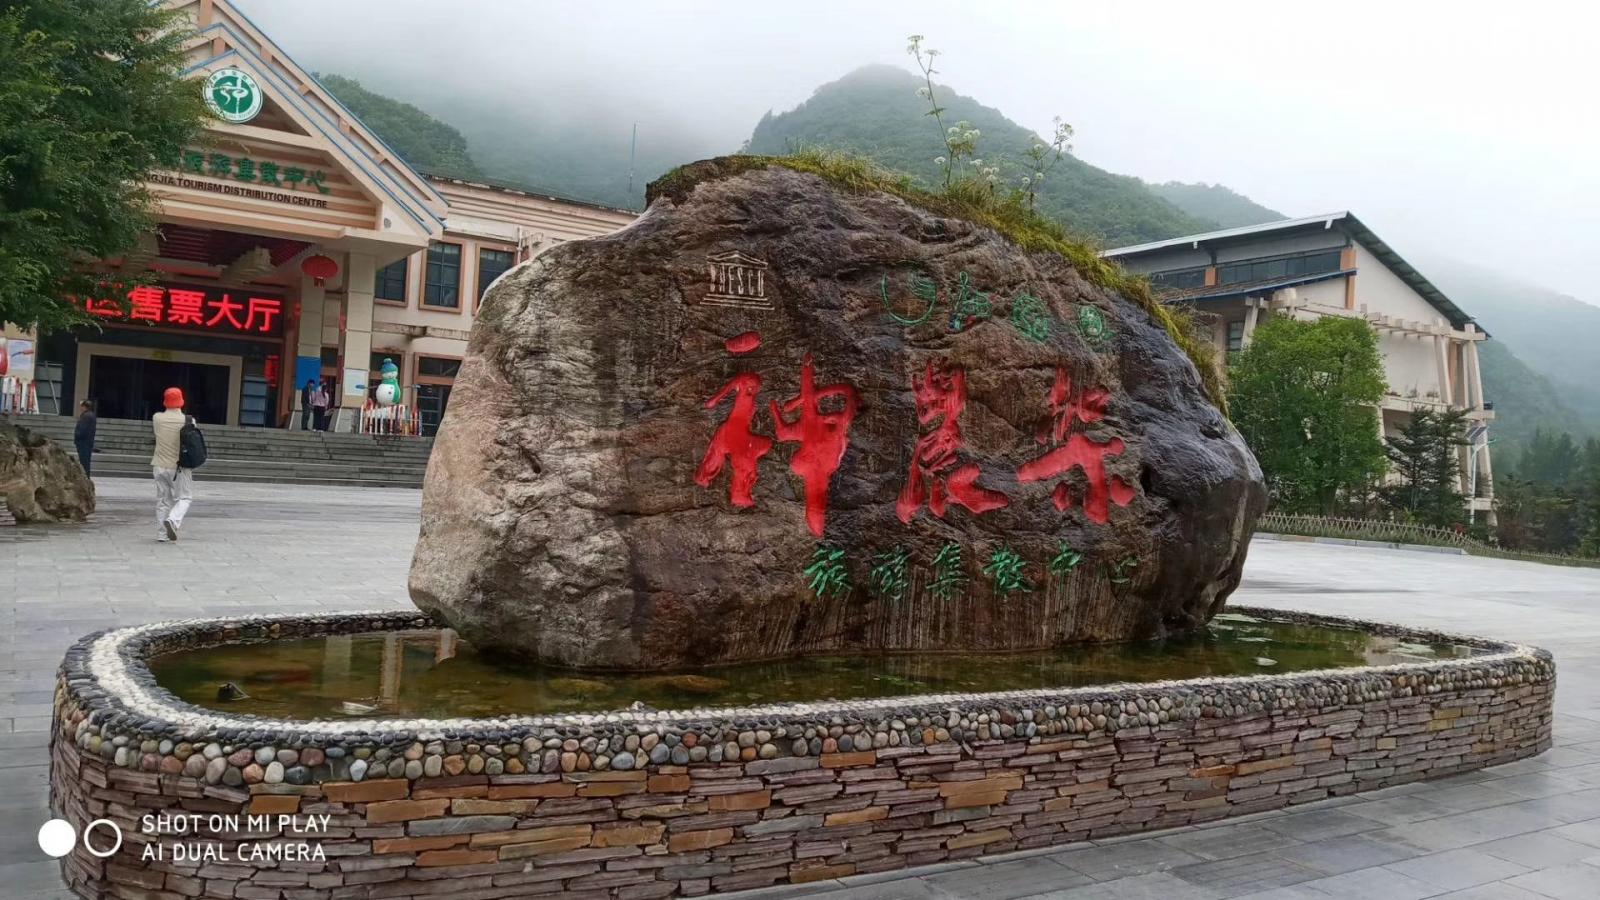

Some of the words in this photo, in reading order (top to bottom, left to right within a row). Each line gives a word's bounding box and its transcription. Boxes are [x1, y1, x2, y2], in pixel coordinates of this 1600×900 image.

[177, 178, 222, 193] TOURISM
[224, 186, 291, 204] DISTRIBUTION
[292, 195, 328, 208] CENTRE
